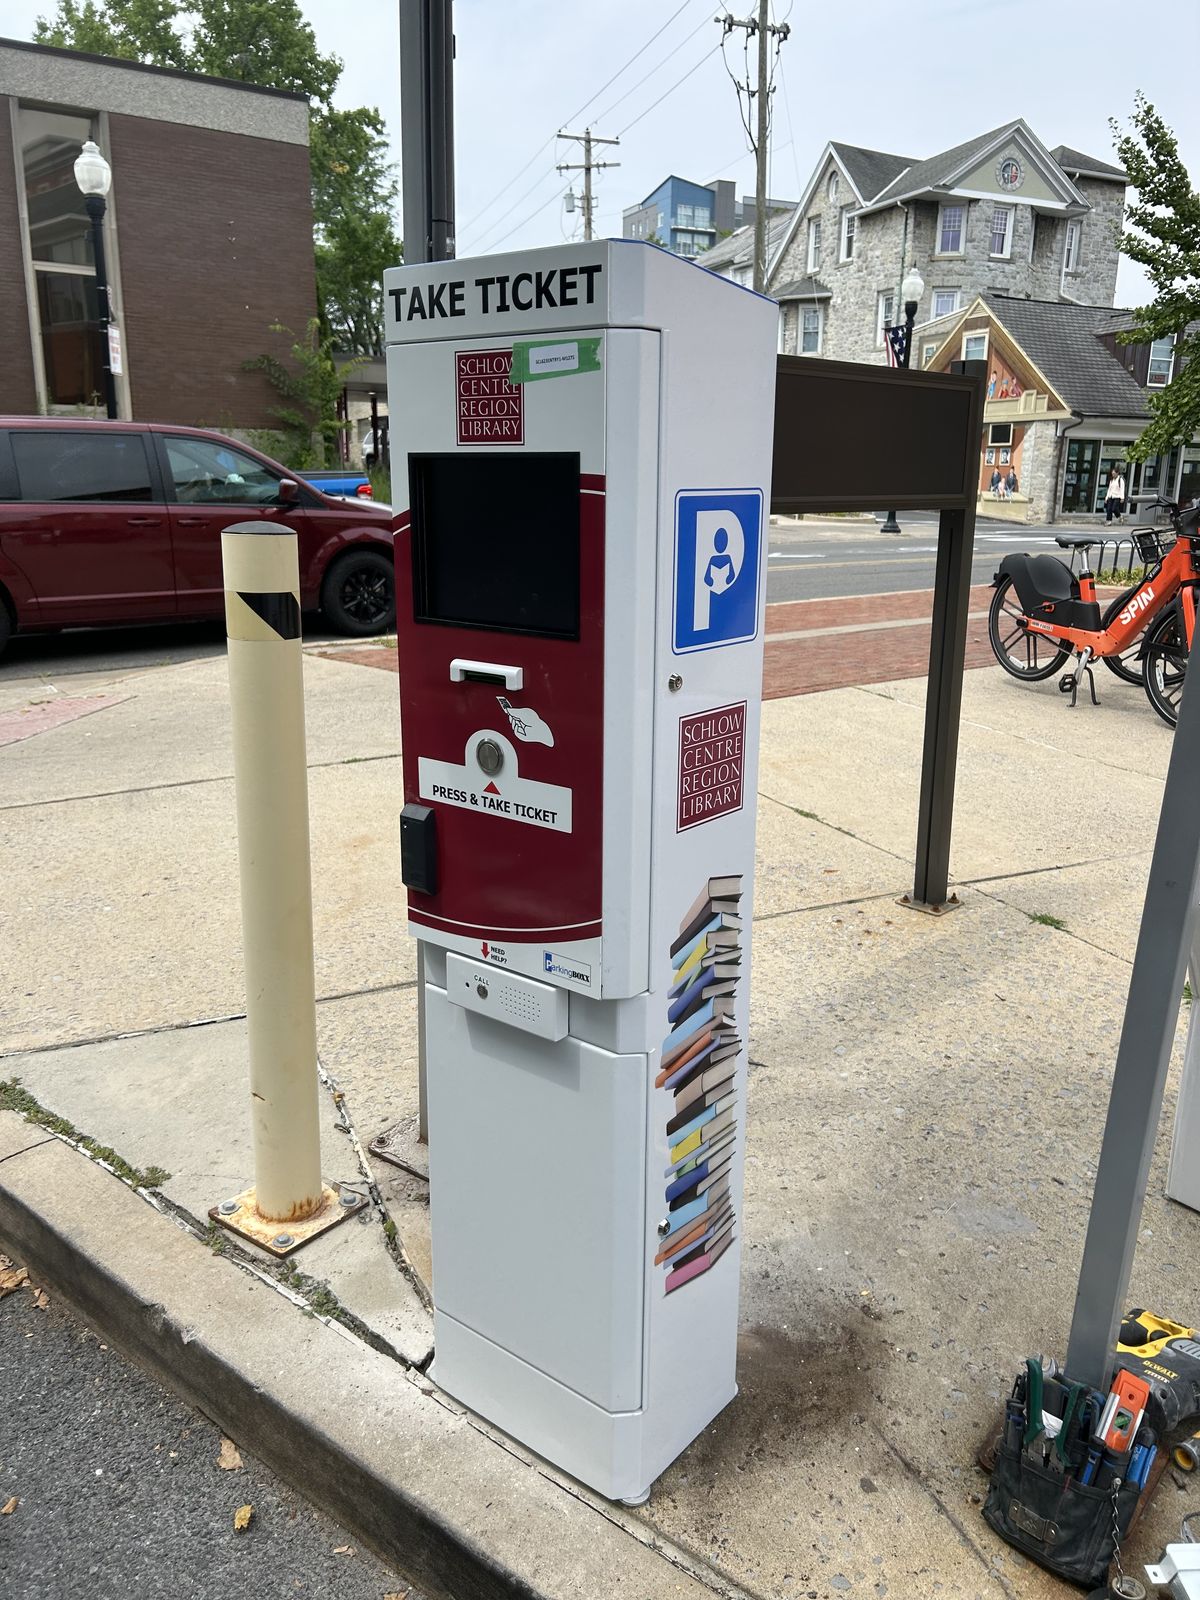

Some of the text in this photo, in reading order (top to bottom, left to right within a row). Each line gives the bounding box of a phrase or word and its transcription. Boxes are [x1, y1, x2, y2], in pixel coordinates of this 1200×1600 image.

[389, 264, 602, 322] TAKE TICKET
[460, 379, 519, 396] CENTRE
[460, 399, 519, 416] REGION
[461, 420, 519, 436] LIBRARY
[1119, 586, 1155, 625] SPIN
[684, 711, 743, 745] SCHLOW
[683, 736, 741, 769] CENTRE
[682, 760, 740, 795] REGION
[432, 784, 558, 824] PRESS & TAKE TICKET
[682, 783, 740, 819] LIBRARY
[490, 946, 505, 956] NEED
[490, 954, 508, 964] HELP?
[473, 974, 490, 986] CALL
